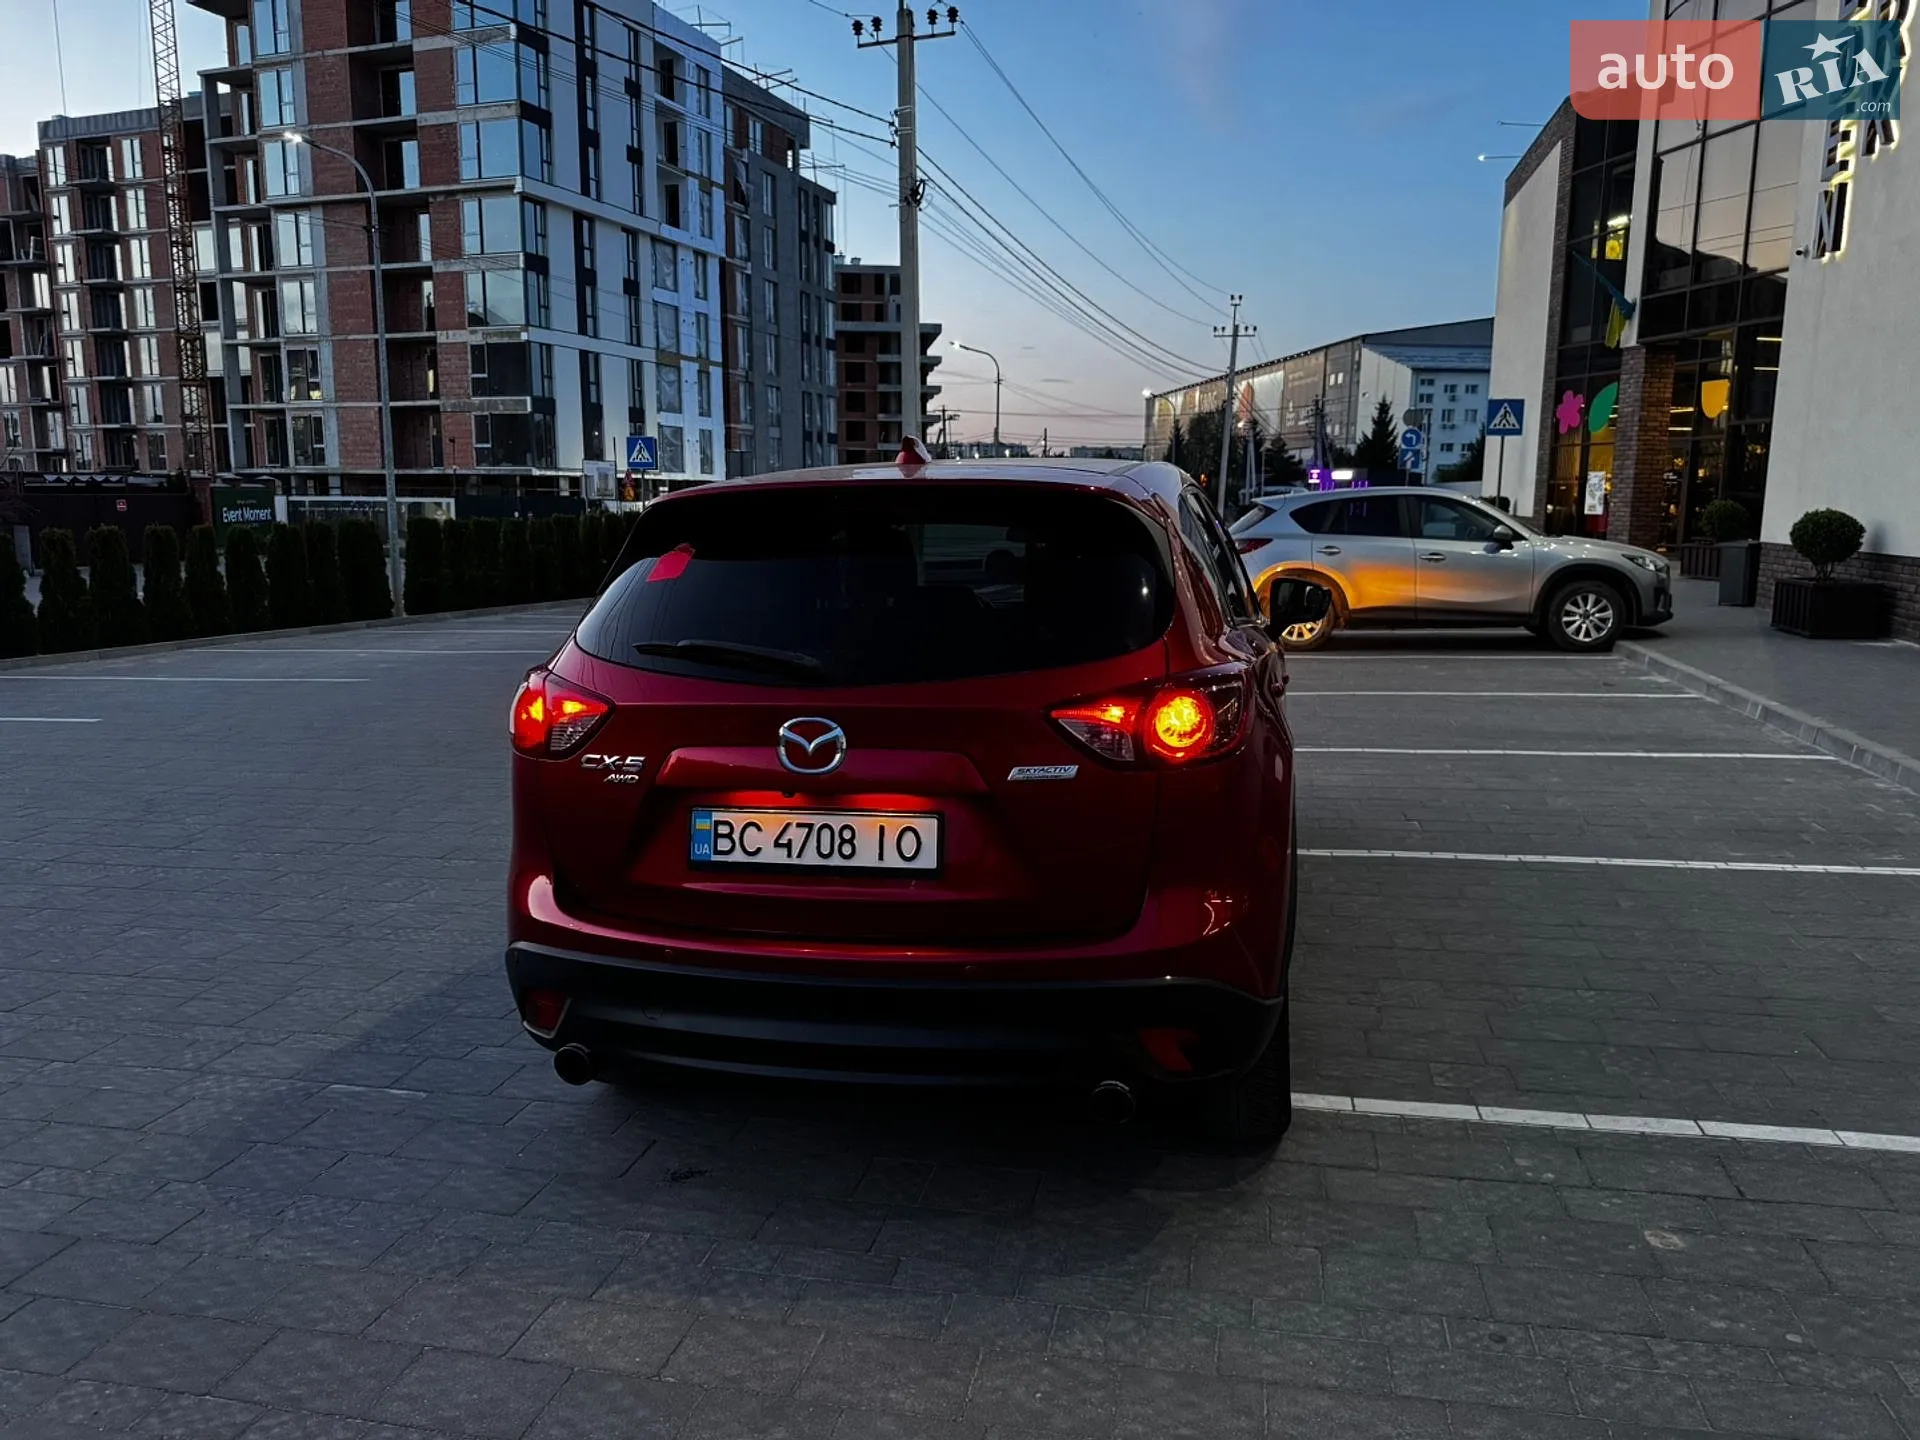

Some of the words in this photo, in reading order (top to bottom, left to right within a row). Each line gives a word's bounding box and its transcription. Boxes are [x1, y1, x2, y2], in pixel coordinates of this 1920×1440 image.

[222, 507, 243, 523] Event
[243, 506, 272, 521] Moment
[581, 754, 646, 773] CX-5
[1017, 766, 1072, 774] SKYACTIV
[604, 773, 640, 783] AWD
[713, 819, 763, 857] BC
[774, 822, 856, 860] 4708
[694, 842, 711, 855] UA
